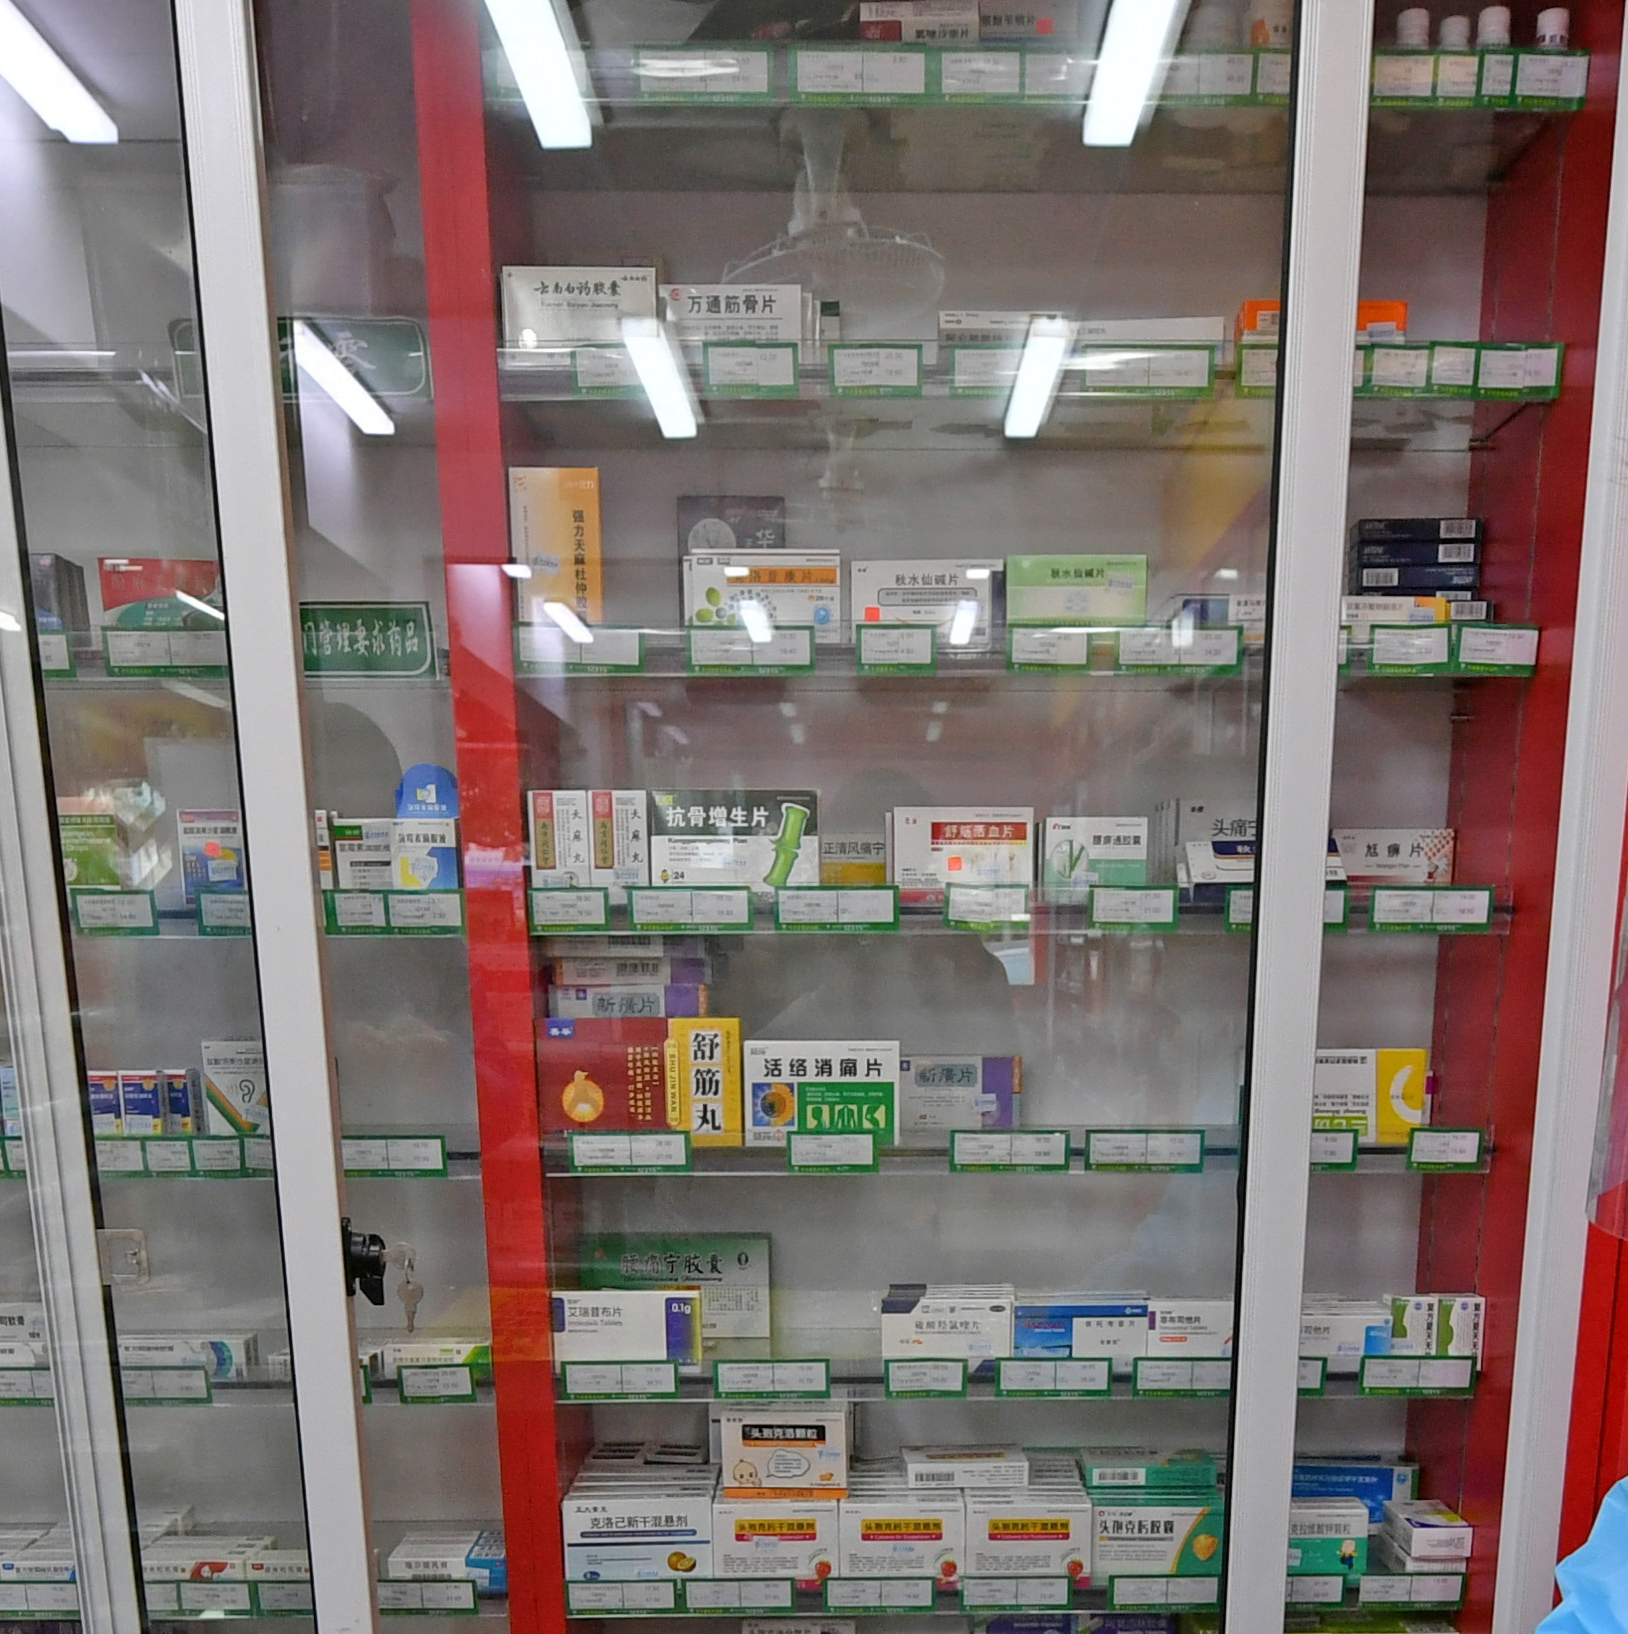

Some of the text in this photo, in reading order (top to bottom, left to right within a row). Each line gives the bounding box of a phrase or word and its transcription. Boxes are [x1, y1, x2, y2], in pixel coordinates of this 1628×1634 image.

[533, 279, 622, 297] 云南白药胶囊
[687, 294, 777, 314] 万通筋骨片
[895, 573, 959, 587] 秋水仙碱片
[666, 806, 770, 828] 抗骨增生片
[571, 808, 586, 865] 天麻丸
[630, 808, 645, 865] 天麻丸
[943, 824, 1015, 840] 舒筋活血片
[822, 842, 885, 856] 正清风痛宁
[673, 871, 686, 881] 24
[763, 1057, 885, 1079] 活络消痛片
[692, 1031, 723, 1133] 舒筋丸
[620, 1253, 724, 1275] 腰痛宁胶囊
[670, 1302, 692, 1316] 0.1g
[748, 1426, 819, 1440] 头孢克洛颗粒
[590, 1514, 689, 1529] 克洛己新干混悬剂
